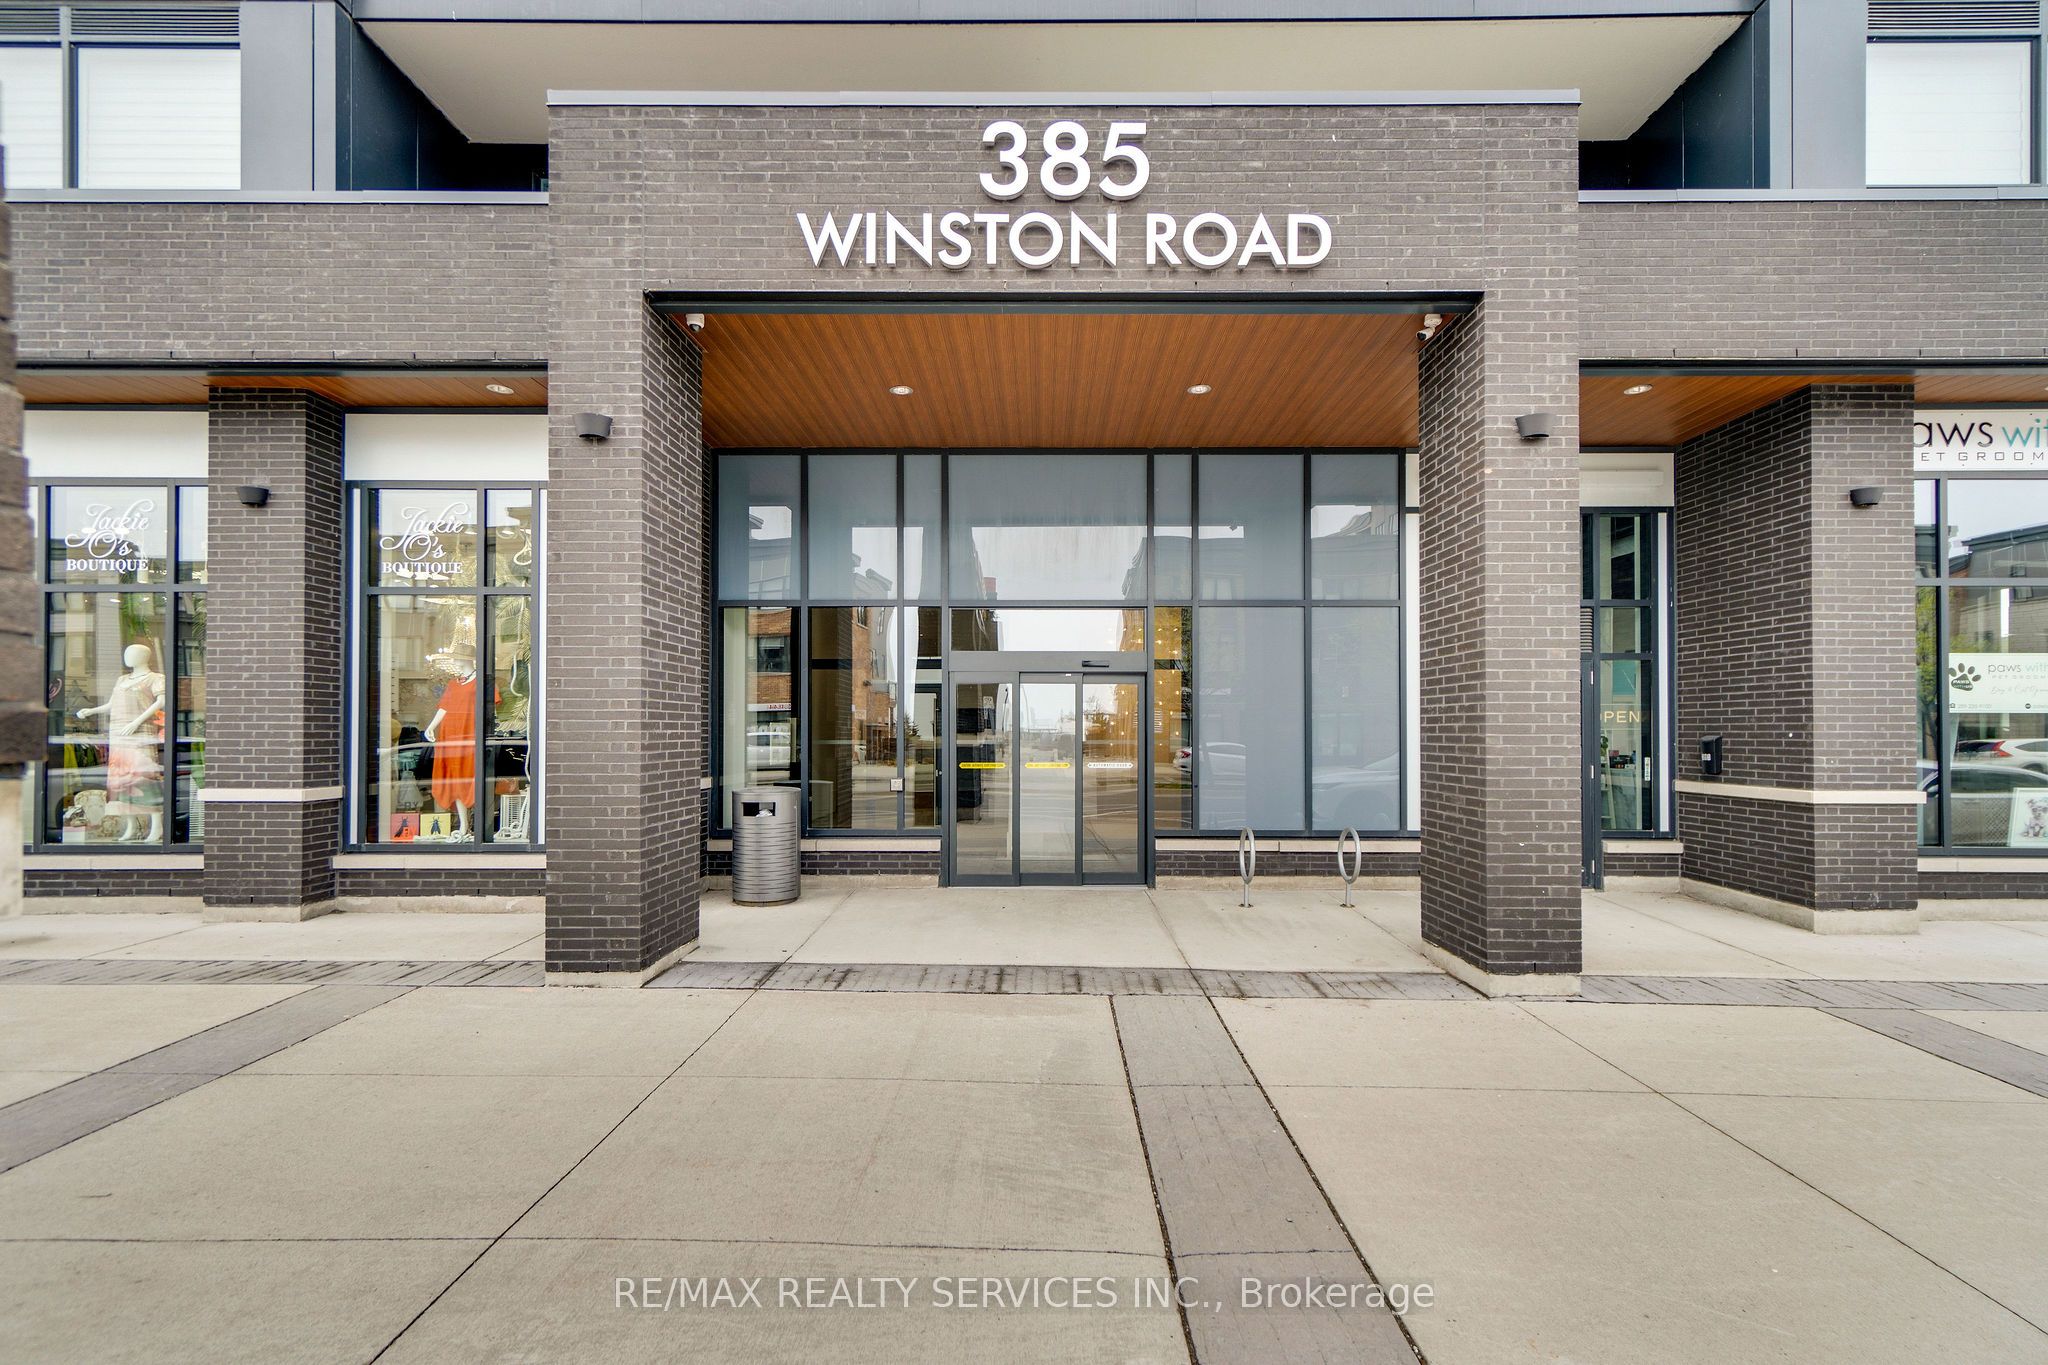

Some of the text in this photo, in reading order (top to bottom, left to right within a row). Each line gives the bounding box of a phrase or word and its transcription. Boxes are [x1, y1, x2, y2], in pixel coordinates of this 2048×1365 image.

[979, 120, 1151, 201] 385
[797, 211, 1333, 270] WINSTON ROAD
[1914, 422, 1993, 448] aws
[1921, 452, 1945, 461] ET
[65, 499, 154, 547] Jackie
[380, 501, 469, 550] Jackie
[88, 529, 133, 558] O's
[402, 532, 447, 561] O's
[66, 559, 148, 573] BOUTIQUE
[382, 562, 463, 576] BOUTIQUE
[1988, 664, 2021, 674] paws
[1600, 710, 1640, 723] PEN
